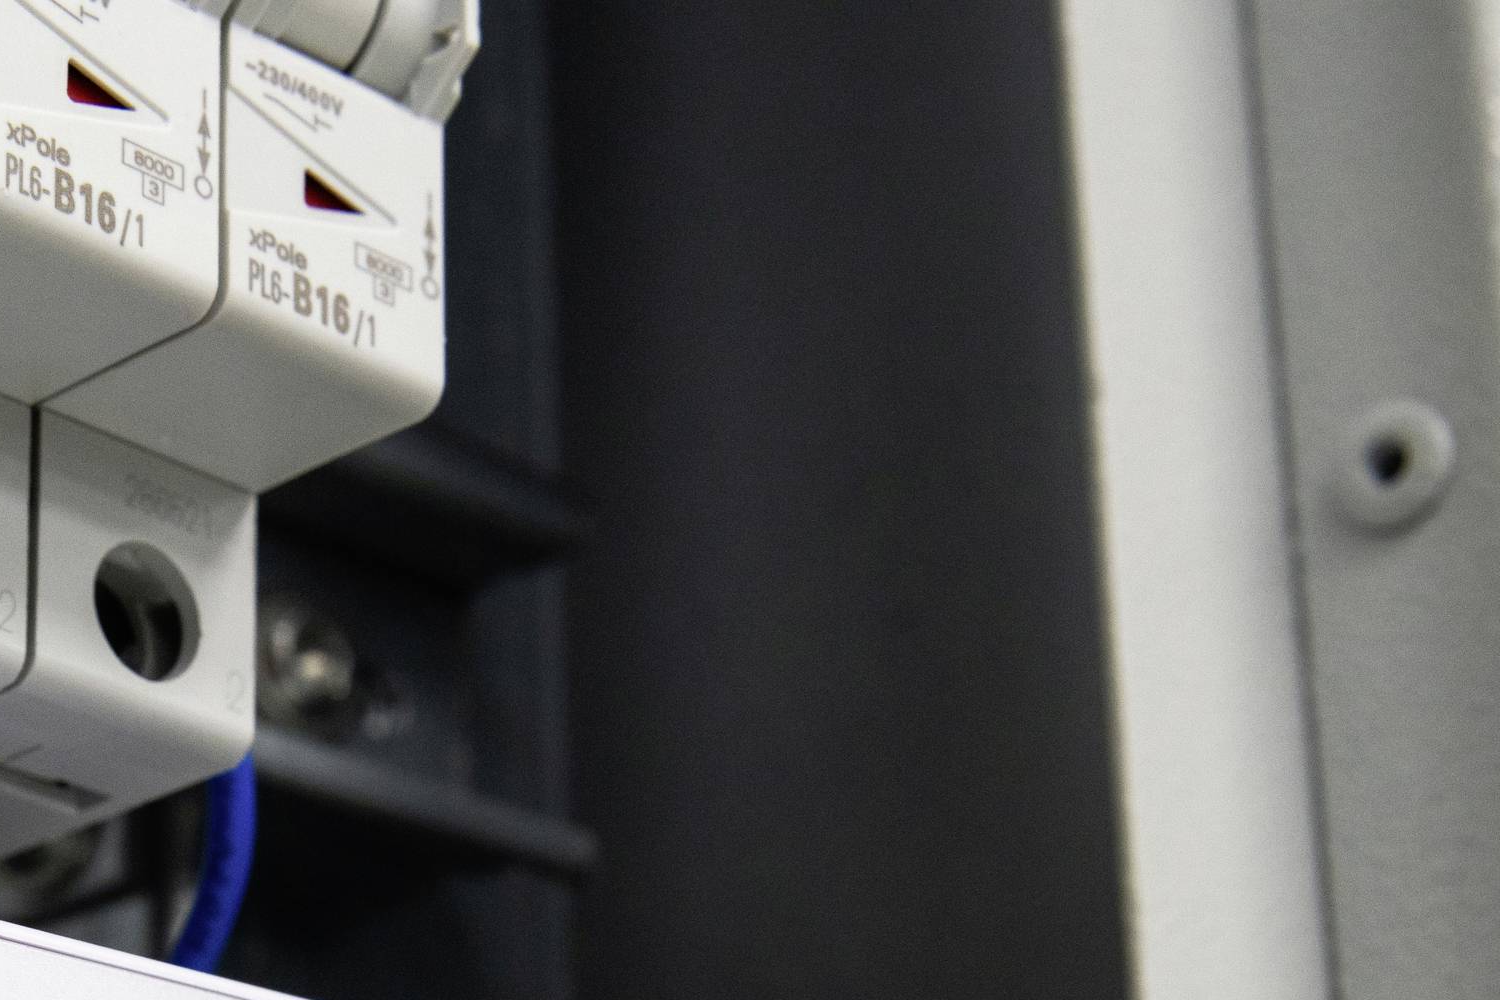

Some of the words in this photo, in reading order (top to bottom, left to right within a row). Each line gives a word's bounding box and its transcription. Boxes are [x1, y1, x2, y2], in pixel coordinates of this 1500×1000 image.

[6, 122, 71, 167] xPole
[5, 152, 144, 248] PL6-B16/1
[149, 180, 159, 197] 3
[249, 228, 307, 270] xPole
[248, 256, 376, 348] PL6-B16/1
